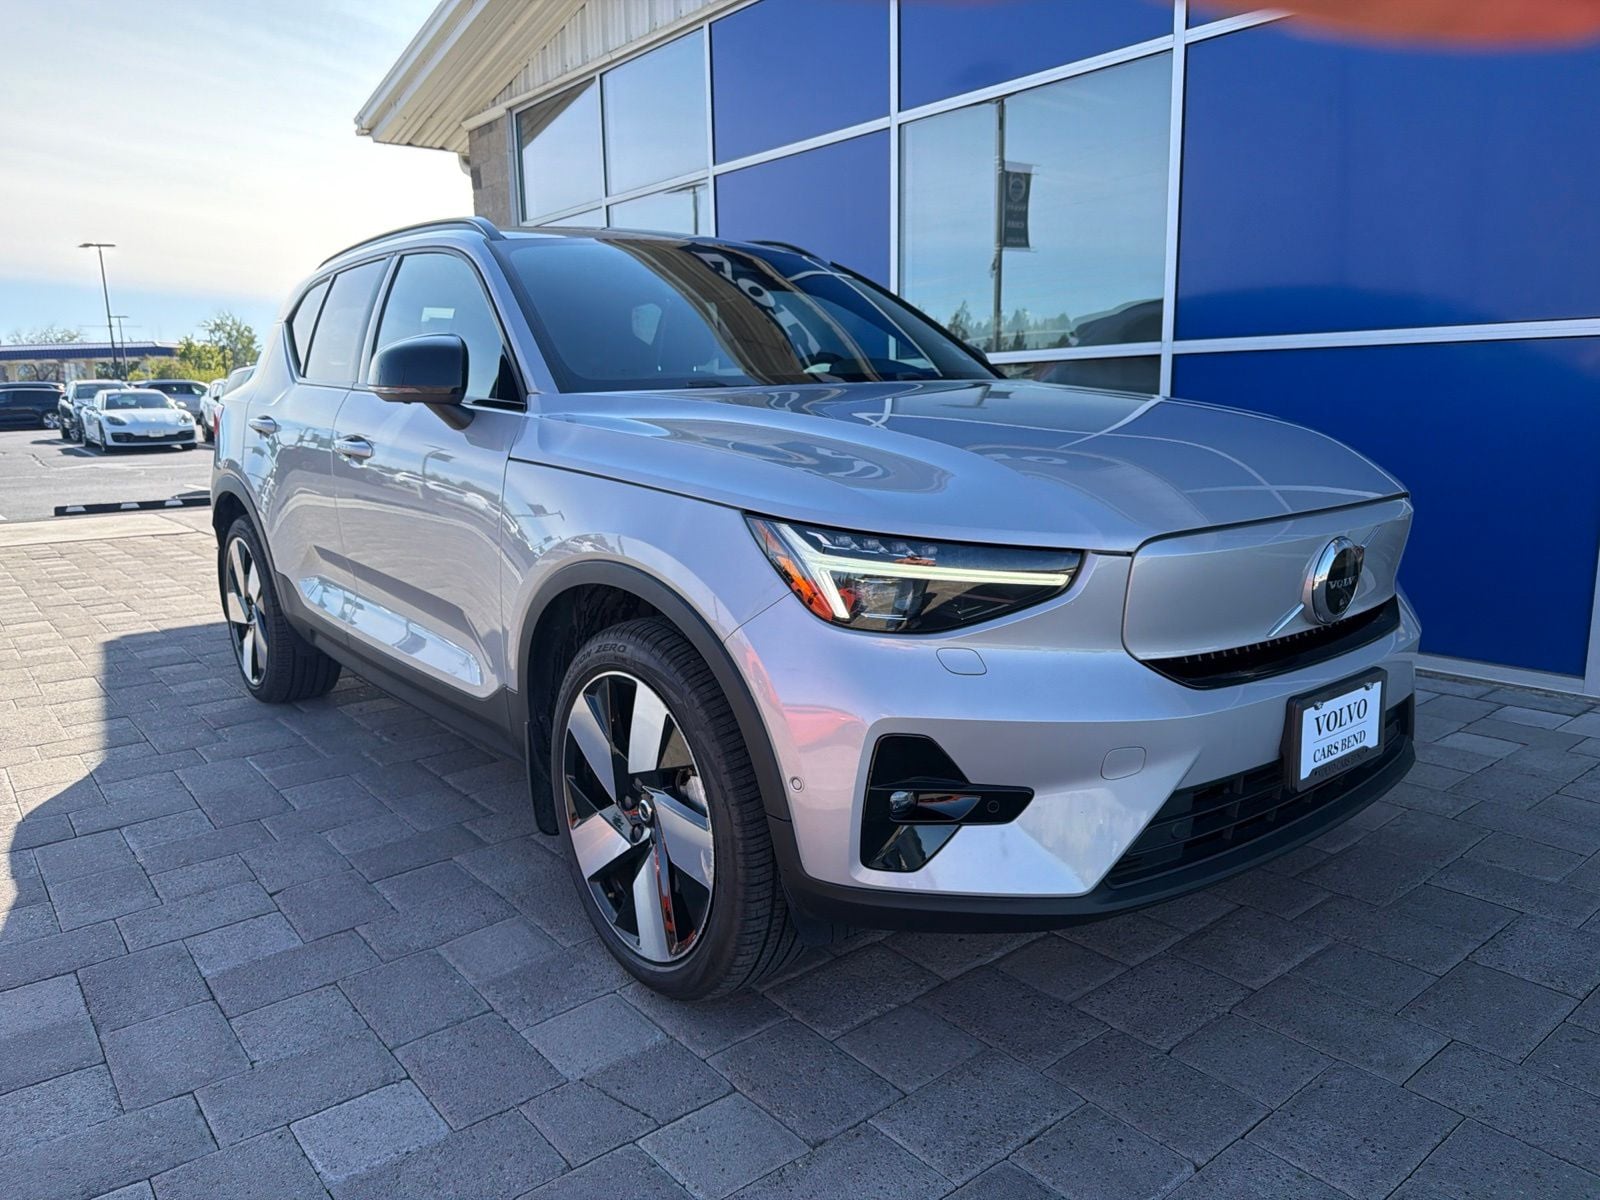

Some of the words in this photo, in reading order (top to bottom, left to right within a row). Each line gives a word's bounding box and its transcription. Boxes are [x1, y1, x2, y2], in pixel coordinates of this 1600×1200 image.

[595, 643, 627, 653] ZERO
[1315, 698, 1368, 736] VOLVO
[1313, 741, 1339, 763] CARS
[1340, 730, 1366, 753] BEND
